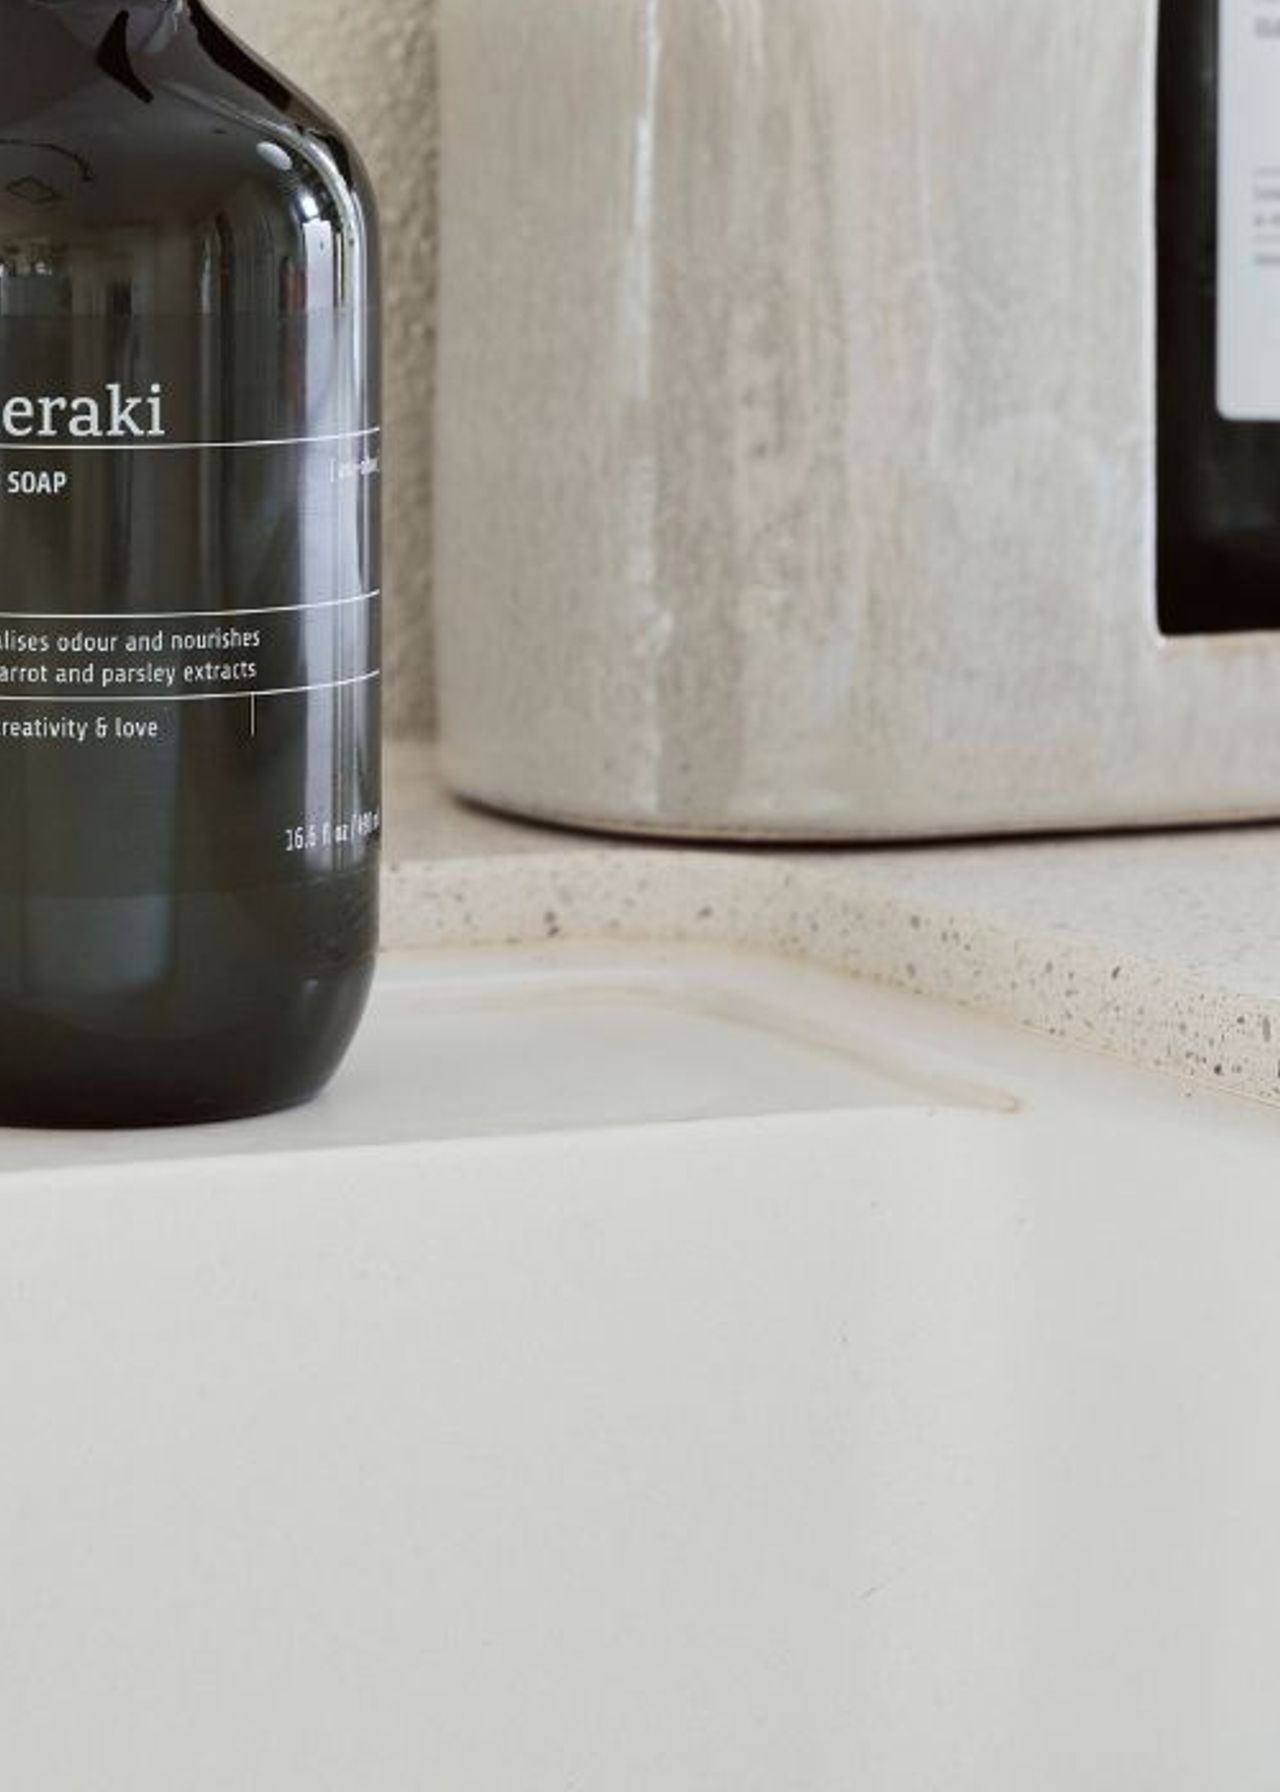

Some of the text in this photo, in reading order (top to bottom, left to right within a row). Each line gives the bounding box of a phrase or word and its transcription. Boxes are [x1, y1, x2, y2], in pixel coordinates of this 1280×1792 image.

[6, 469, 68, 495] SOAP
[55, 630, 118, 653] odour
[124, 629, 164, 653] and
[170, 626, 261, 650] nourishes
[55, 662, 95, 684] and
[101, 662, 177, 689] parsley
[182, 660, 258, 683] extracts
[94, 716, 109, 739] &
[114, 716, 159, 738] love
